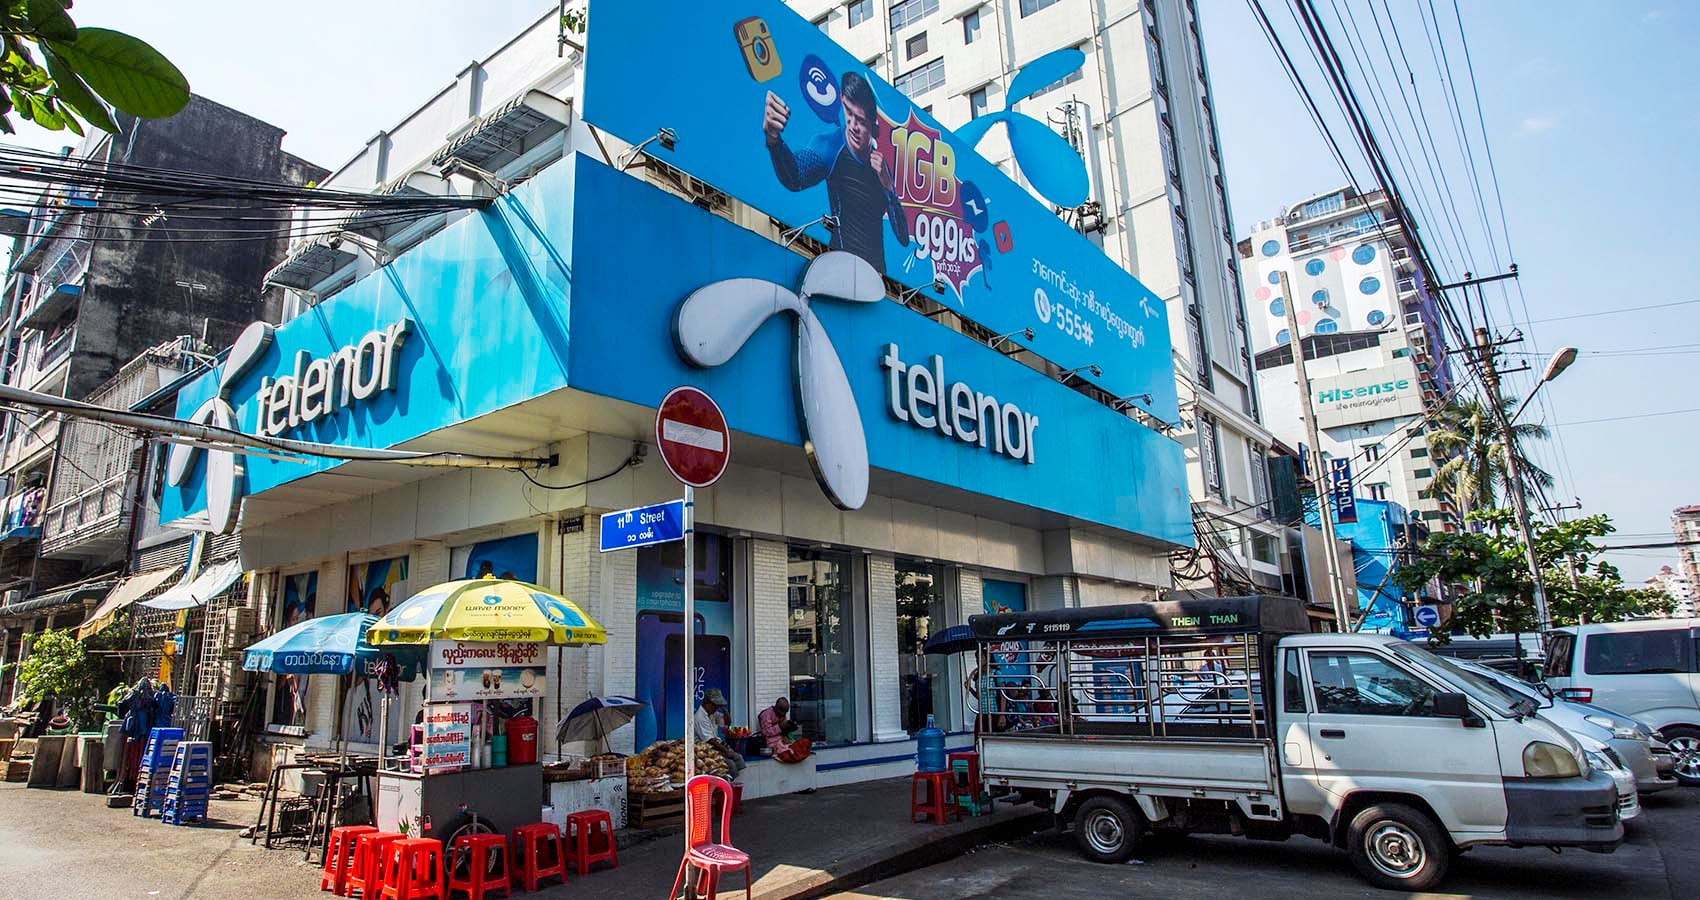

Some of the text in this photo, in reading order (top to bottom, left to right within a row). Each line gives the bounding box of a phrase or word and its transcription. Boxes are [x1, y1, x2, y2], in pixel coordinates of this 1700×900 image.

[890, 126, 956, 207] 1GB
[256, 318, 414, 437] telenor
[880, 342, 1039, 464] telenor
[1319, 379, 1409, 404] Hisense
[617, 510, 665, 529] 11th Street
[1044, 623, 1070, 633] 5115119
[1171, 614, 1238, 626] THEIN THAN
